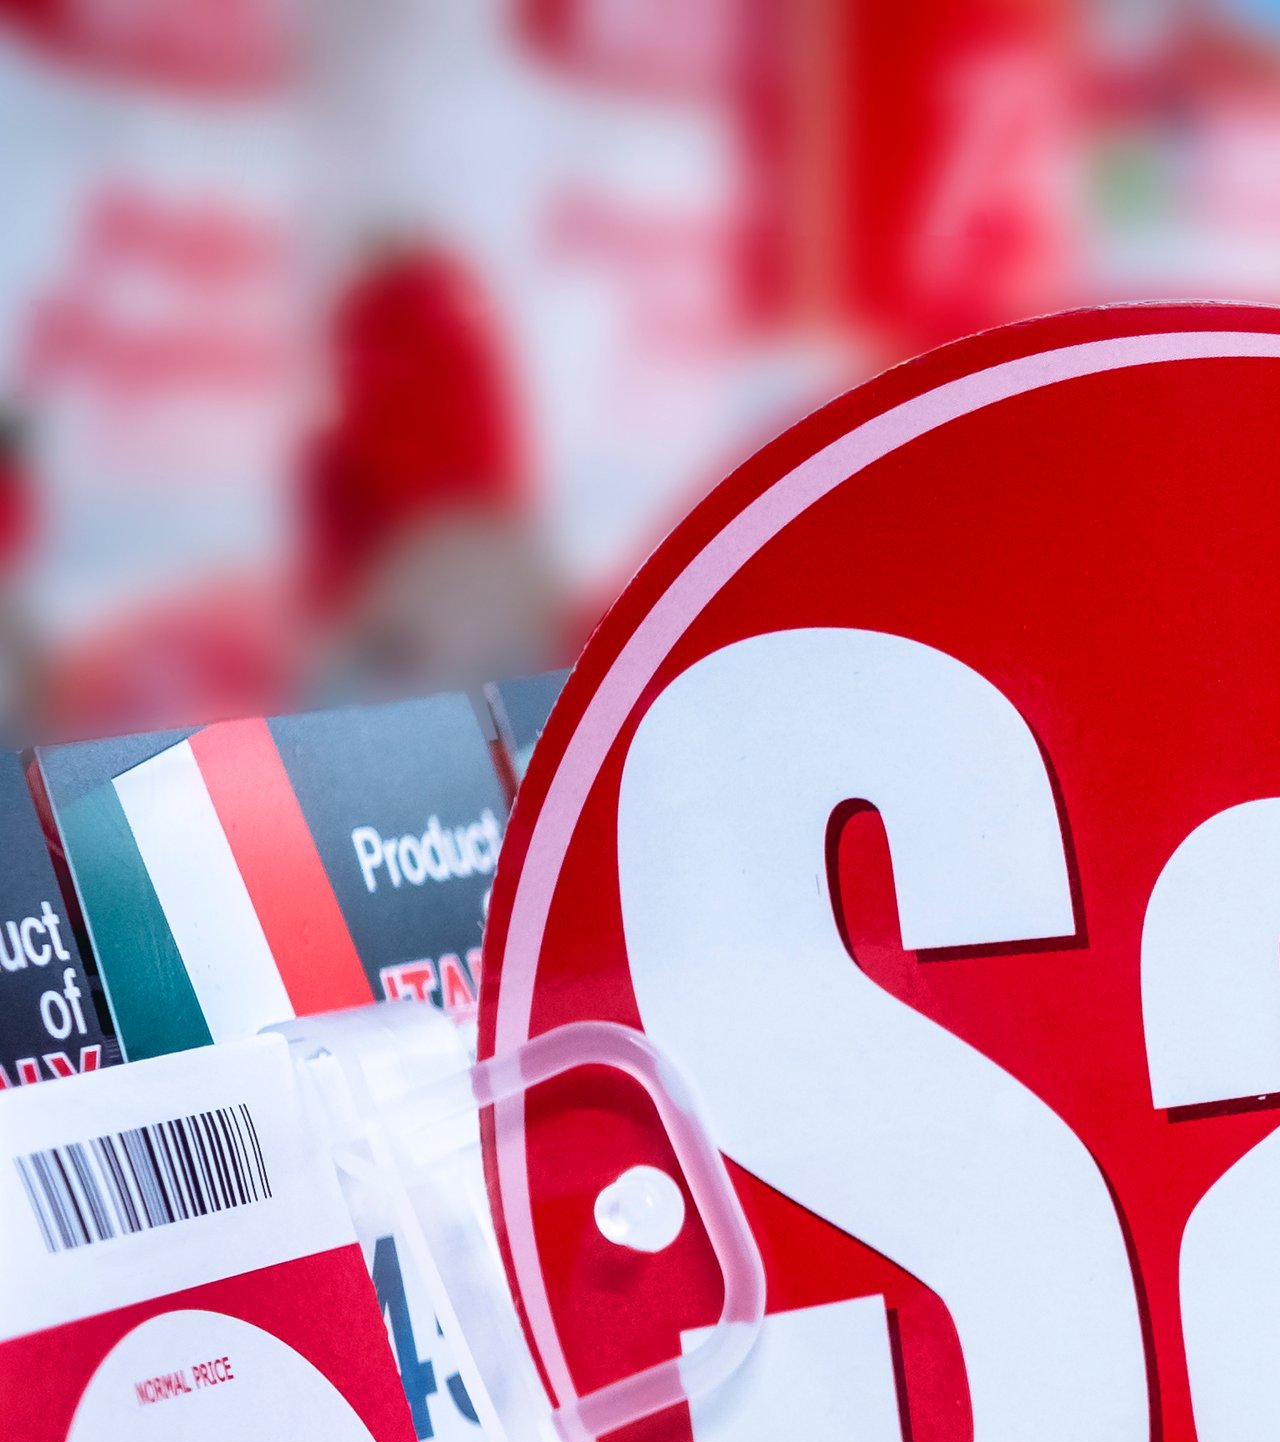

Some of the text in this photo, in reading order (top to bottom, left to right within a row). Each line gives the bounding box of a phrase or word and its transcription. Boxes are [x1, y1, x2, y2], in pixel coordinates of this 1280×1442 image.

[40, 967, 87, 1040] of
[135, 1356, 235, 1406] NORMAL PRICE
